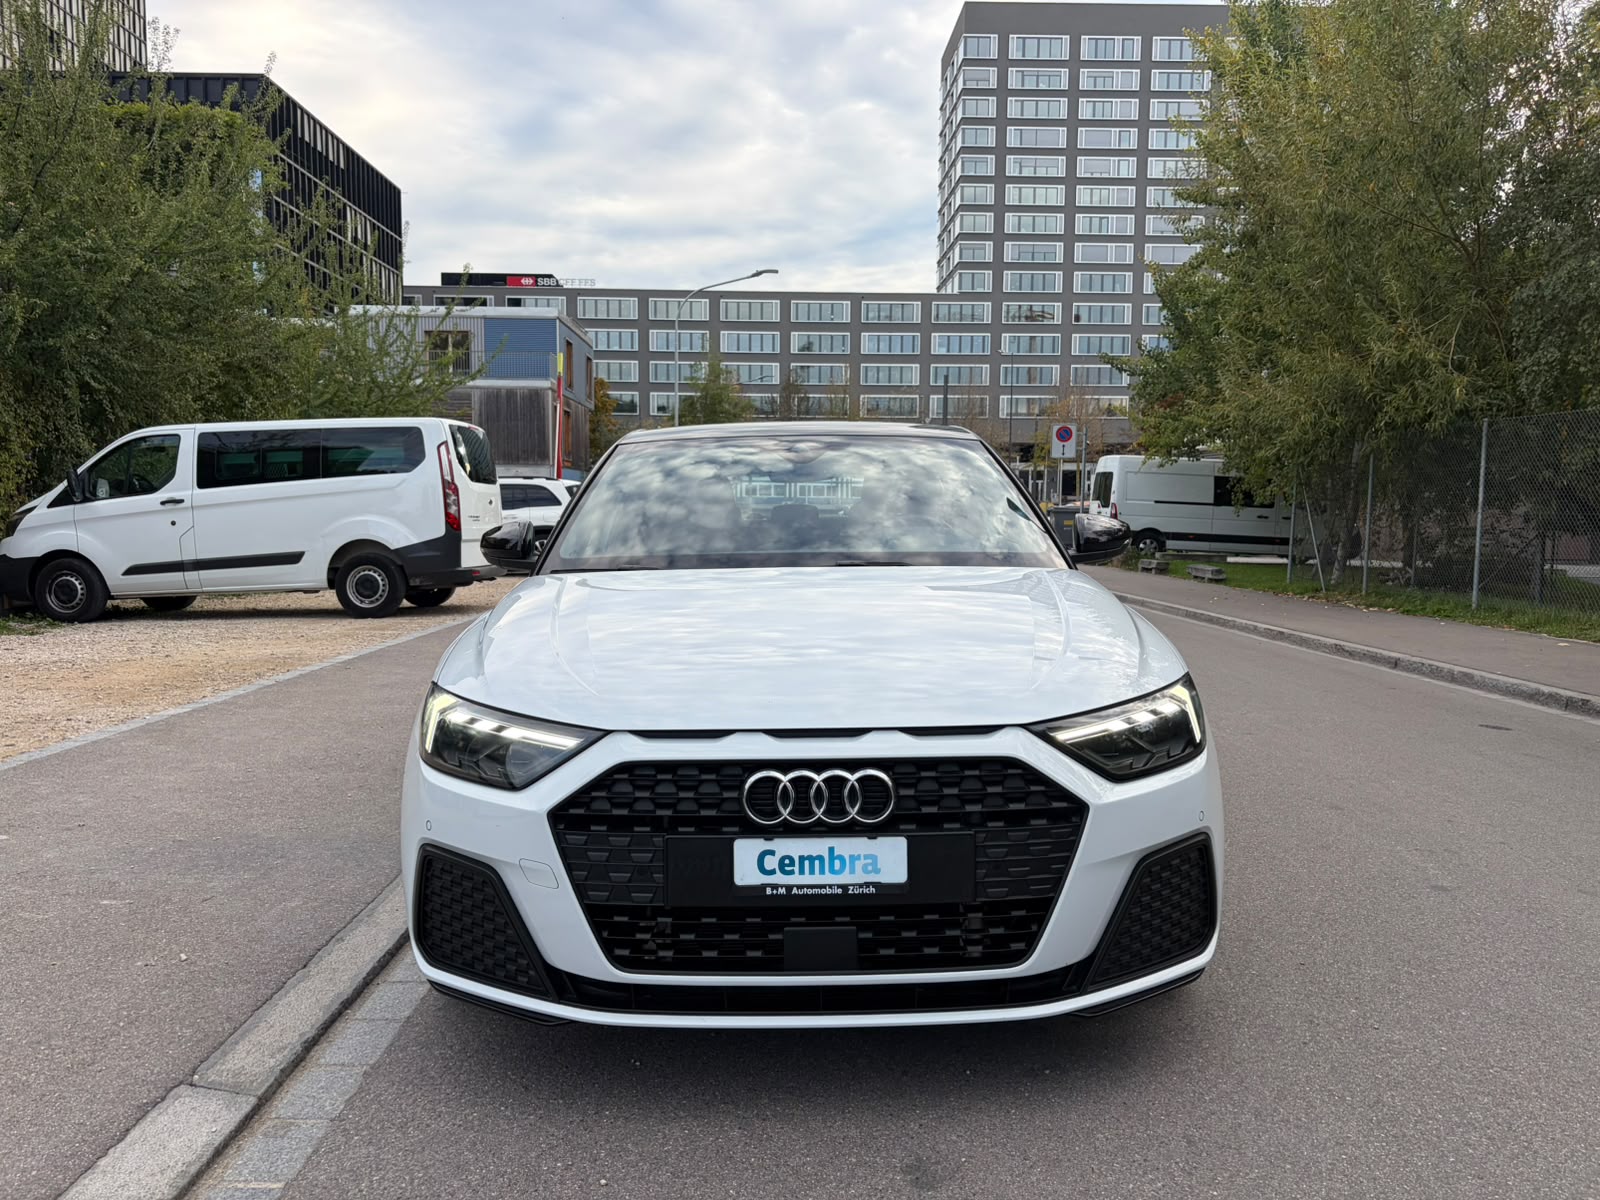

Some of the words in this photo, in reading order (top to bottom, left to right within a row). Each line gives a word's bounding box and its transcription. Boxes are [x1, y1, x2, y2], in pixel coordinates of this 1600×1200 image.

[537, 277, 557, 286] SBB
[756, 846, 882, 876] Cembra
[765, 886, 787, 895] B+M
[791, 885, 843, 895] Automobile
[847, 885, 876, 895] Zürich
